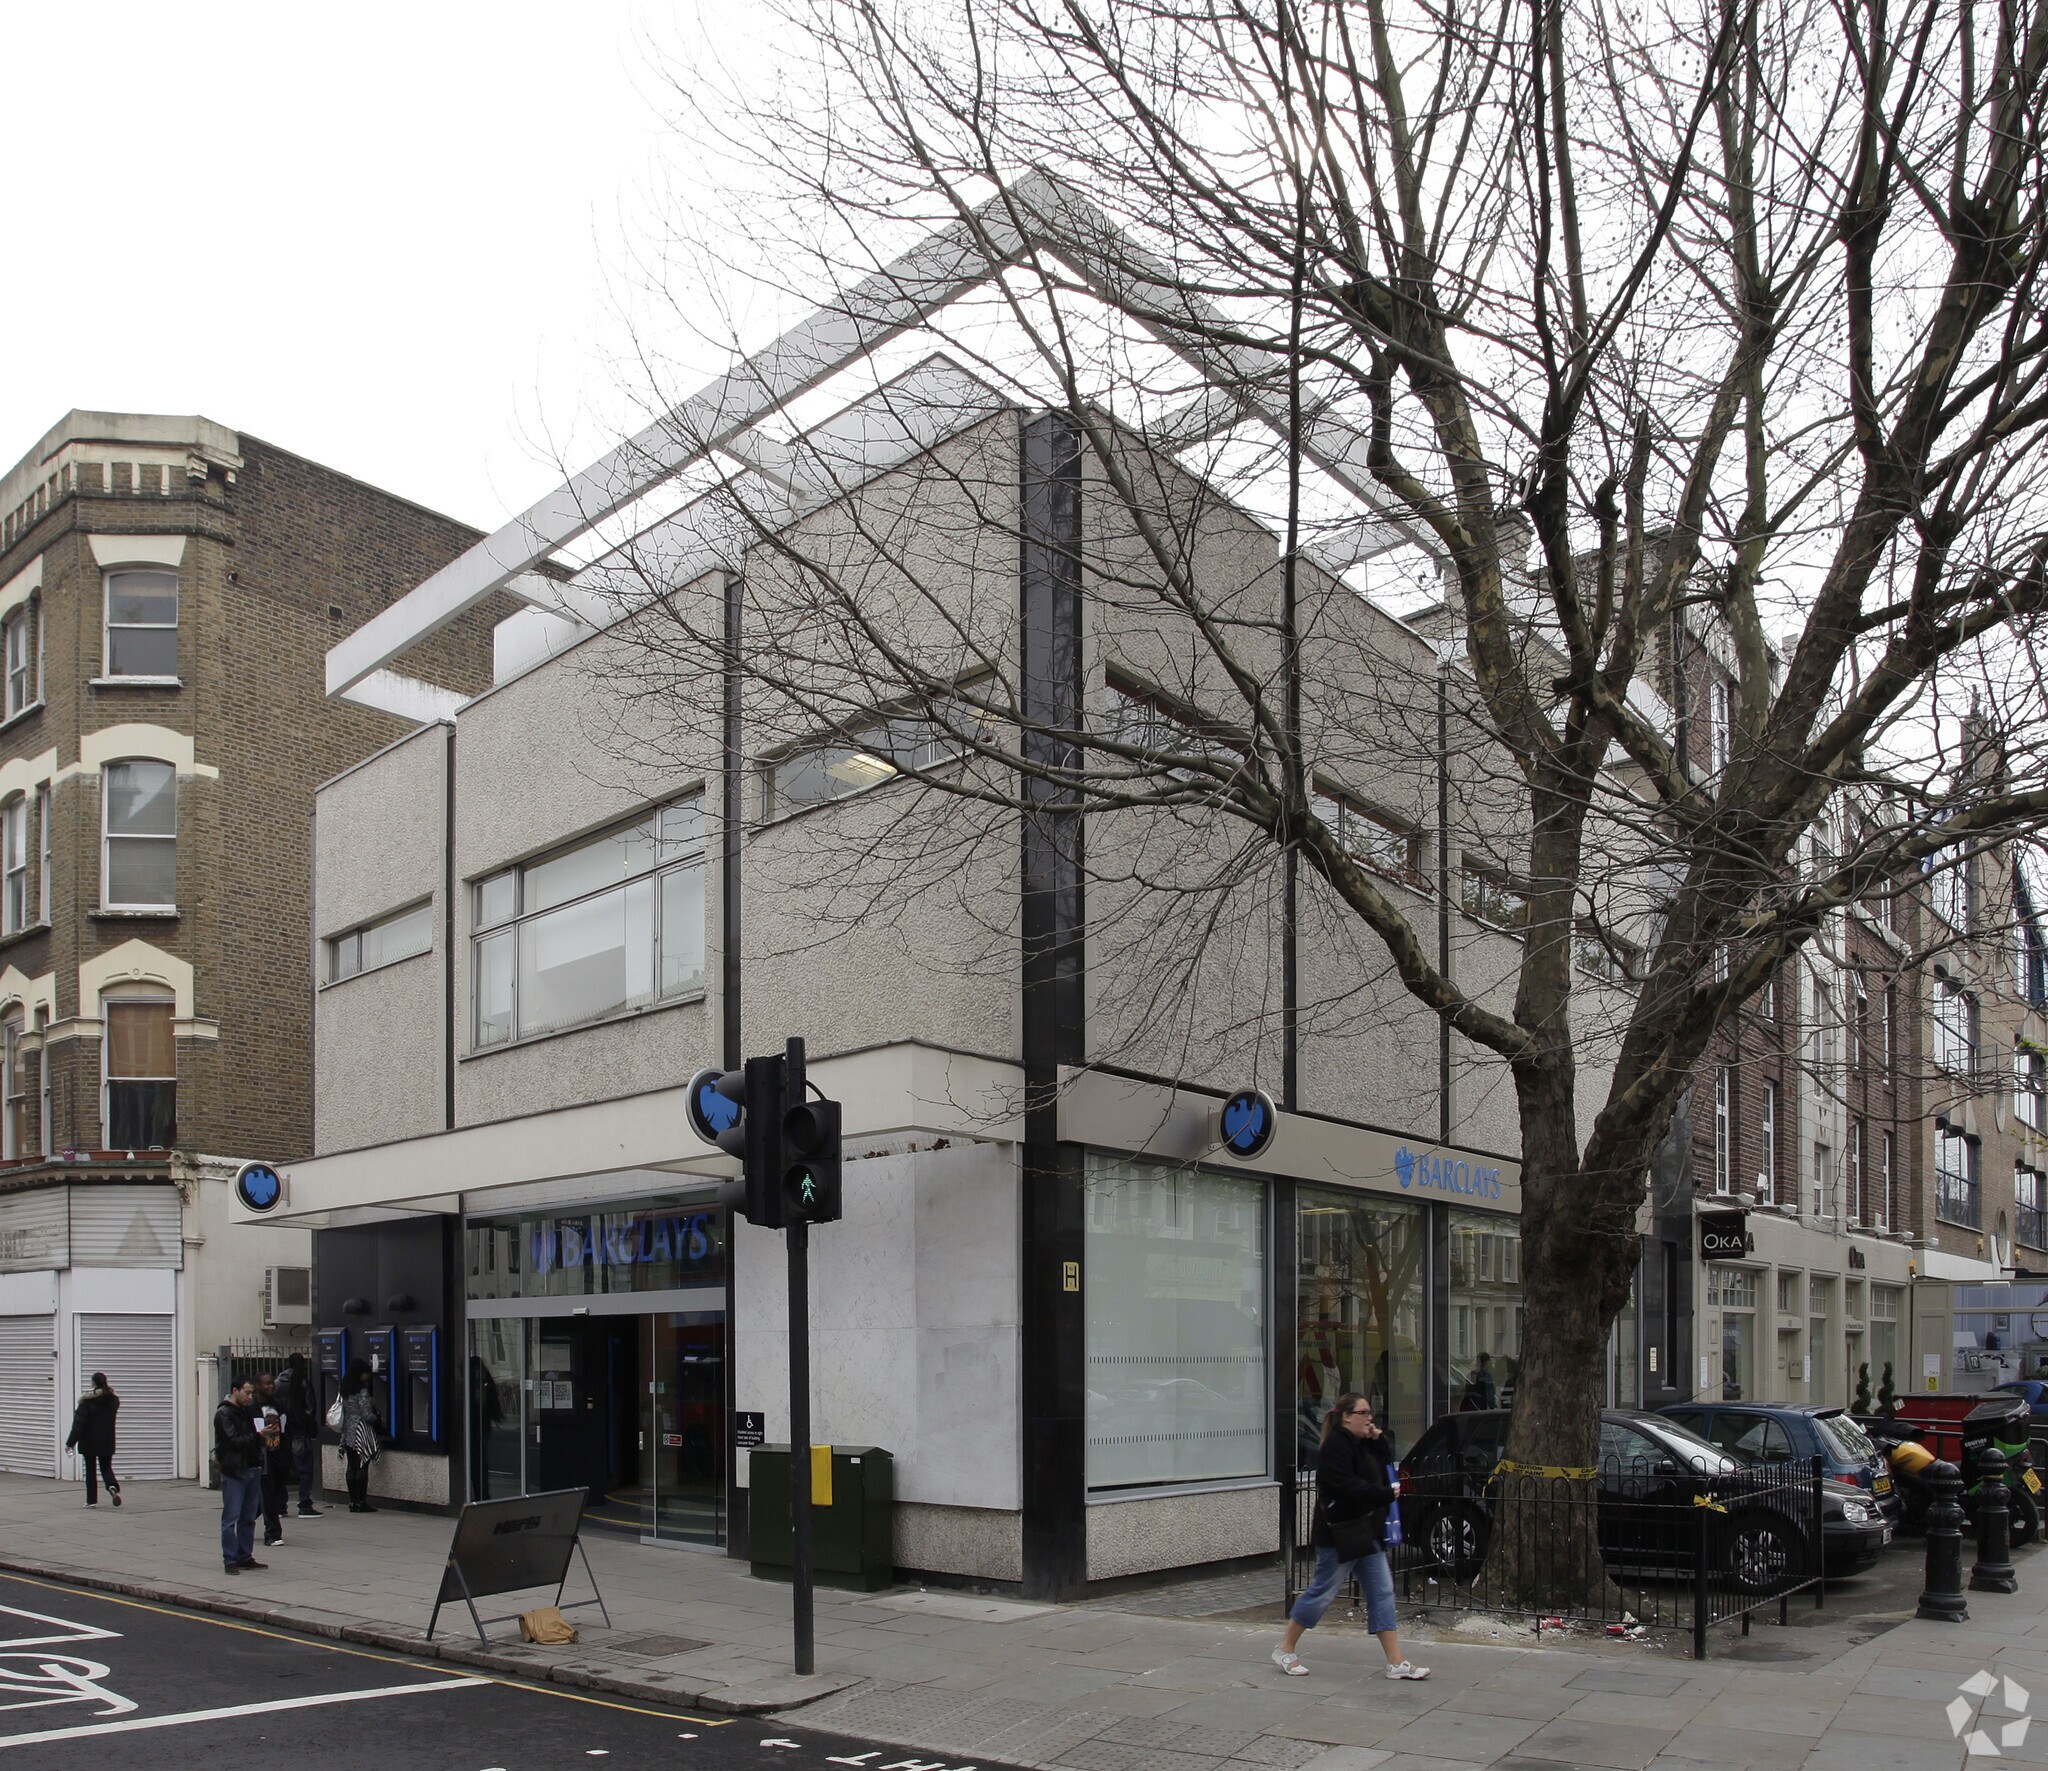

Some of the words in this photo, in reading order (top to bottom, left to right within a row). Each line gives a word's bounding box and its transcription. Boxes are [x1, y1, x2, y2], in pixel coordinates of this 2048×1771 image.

[1418, 1153, 1501, 1200] BARCLAYS
[561, 1214, 709, 1268] BARCLAYS
[1704, 1233, 1742, 1249] OKA
[1514, 1463, 1543, 1471] CAUTION
